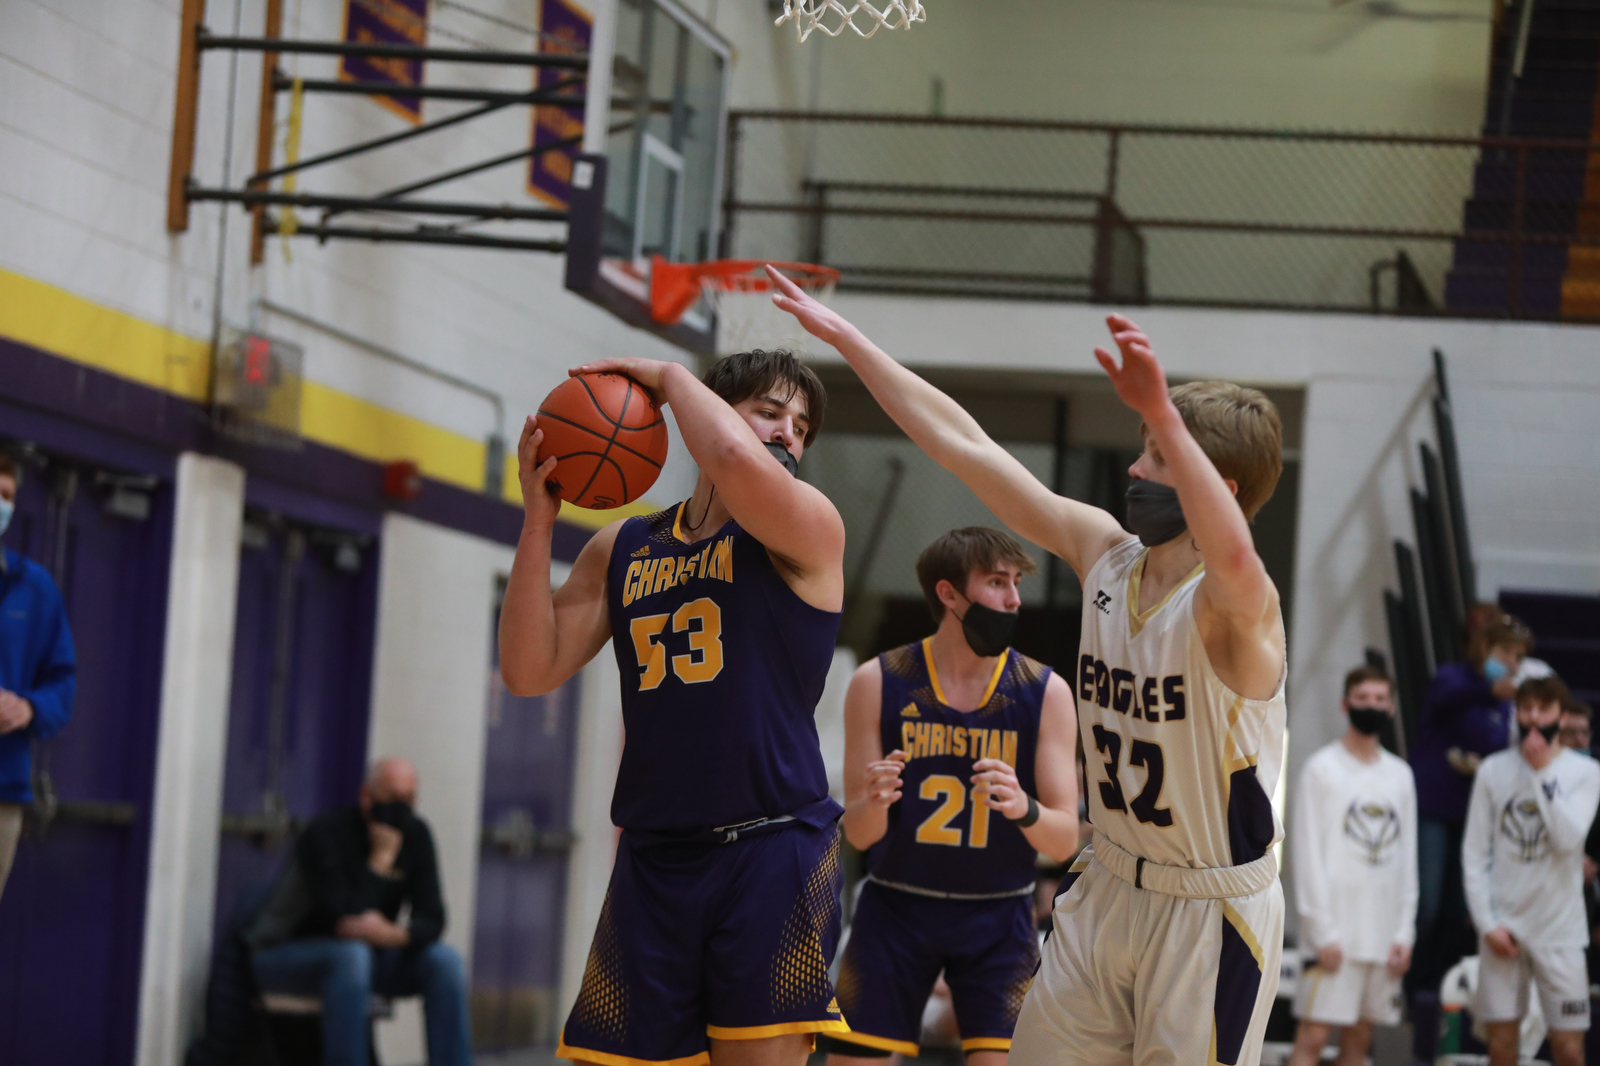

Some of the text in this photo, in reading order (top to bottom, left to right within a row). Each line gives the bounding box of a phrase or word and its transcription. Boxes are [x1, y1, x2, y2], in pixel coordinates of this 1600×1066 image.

[622, 535, 734, 608] CHRISIAN
[630, 597, 724, 692] 53
[1080, 654, 1186, 723] EAGLES
[902, 721, 1018, 770] CHRISTIAN
[1092, 722, 1176, 828] 32
[916, 774, 991, 848] 21
